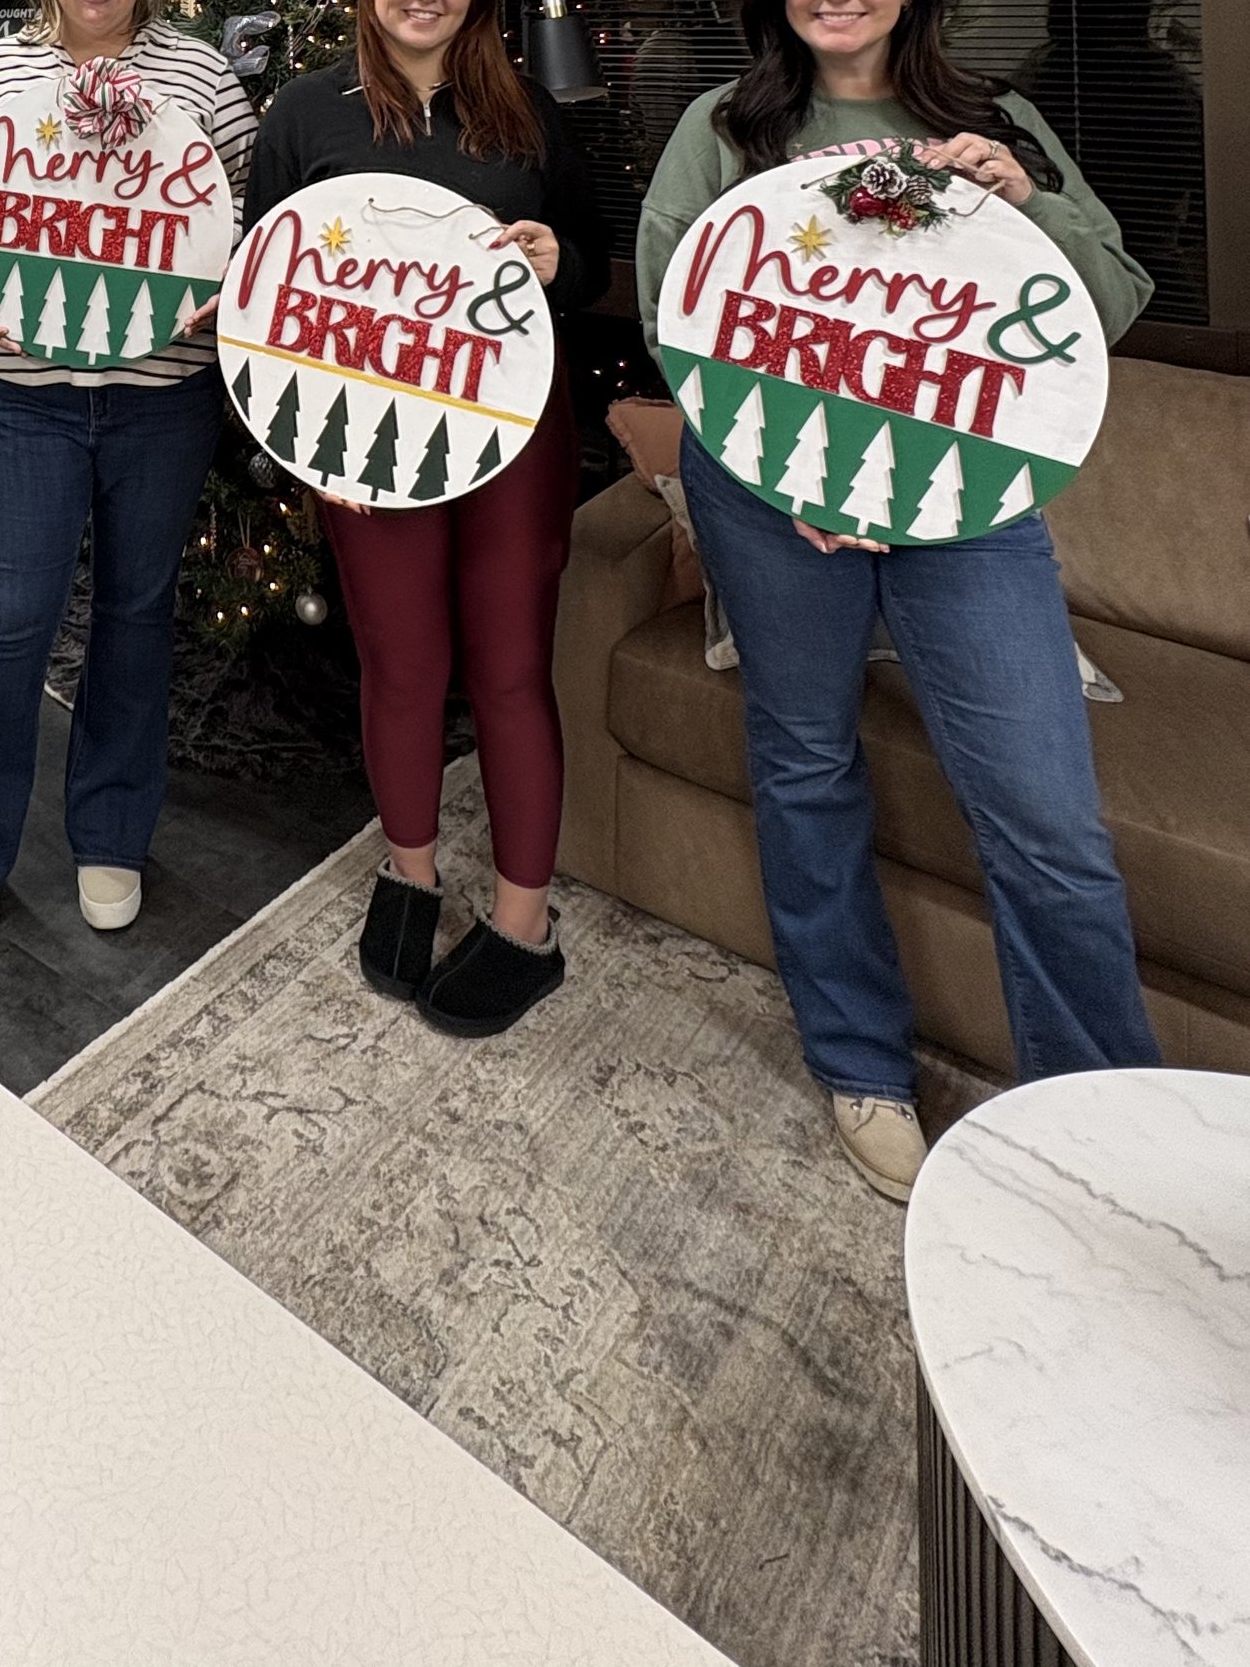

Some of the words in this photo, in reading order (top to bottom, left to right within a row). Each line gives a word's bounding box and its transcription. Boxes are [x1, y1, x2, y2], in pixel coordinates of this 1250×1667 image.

[160, 141, 217, 208] &
[238, 209, 474, 319] Merry
[466, 260, 535, 335] &
[682, 205, 996, 344] Merry
[986, 274, 1081, 364] &
[265, 283, 502, 402] BRIGHT
[711, 289, 1026, 438] BRIGHT
